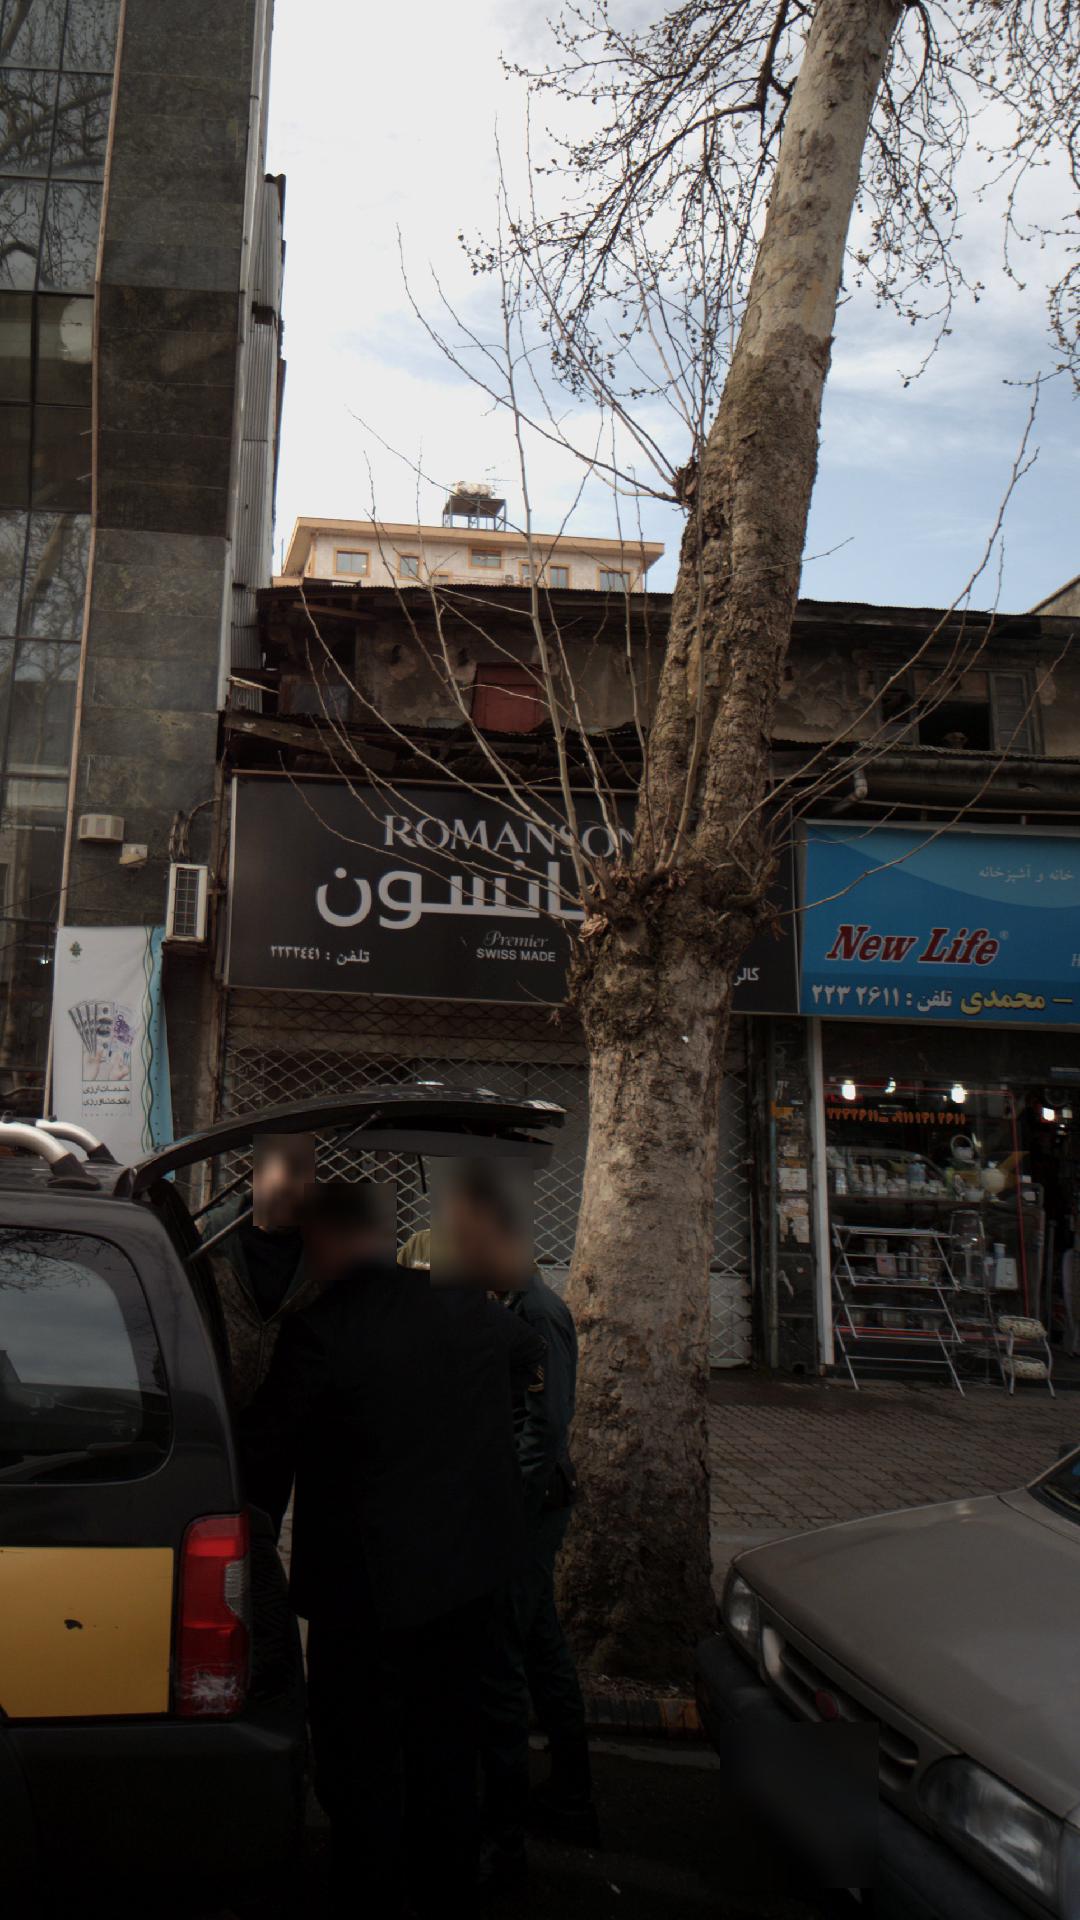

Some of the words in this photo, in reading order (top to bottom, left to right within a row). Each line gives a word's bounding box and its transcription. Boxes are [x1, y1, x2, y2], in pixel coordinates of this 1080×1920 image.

[482, 929, 549, 948] Premier
[825, 924, 917, 963] New
[917, 927, 999, 966] Life
[476, 948, 517, 960] SWISS
[521, 950, 556, 962] MADE
[960, 989, 1046, 1015] محمدی
